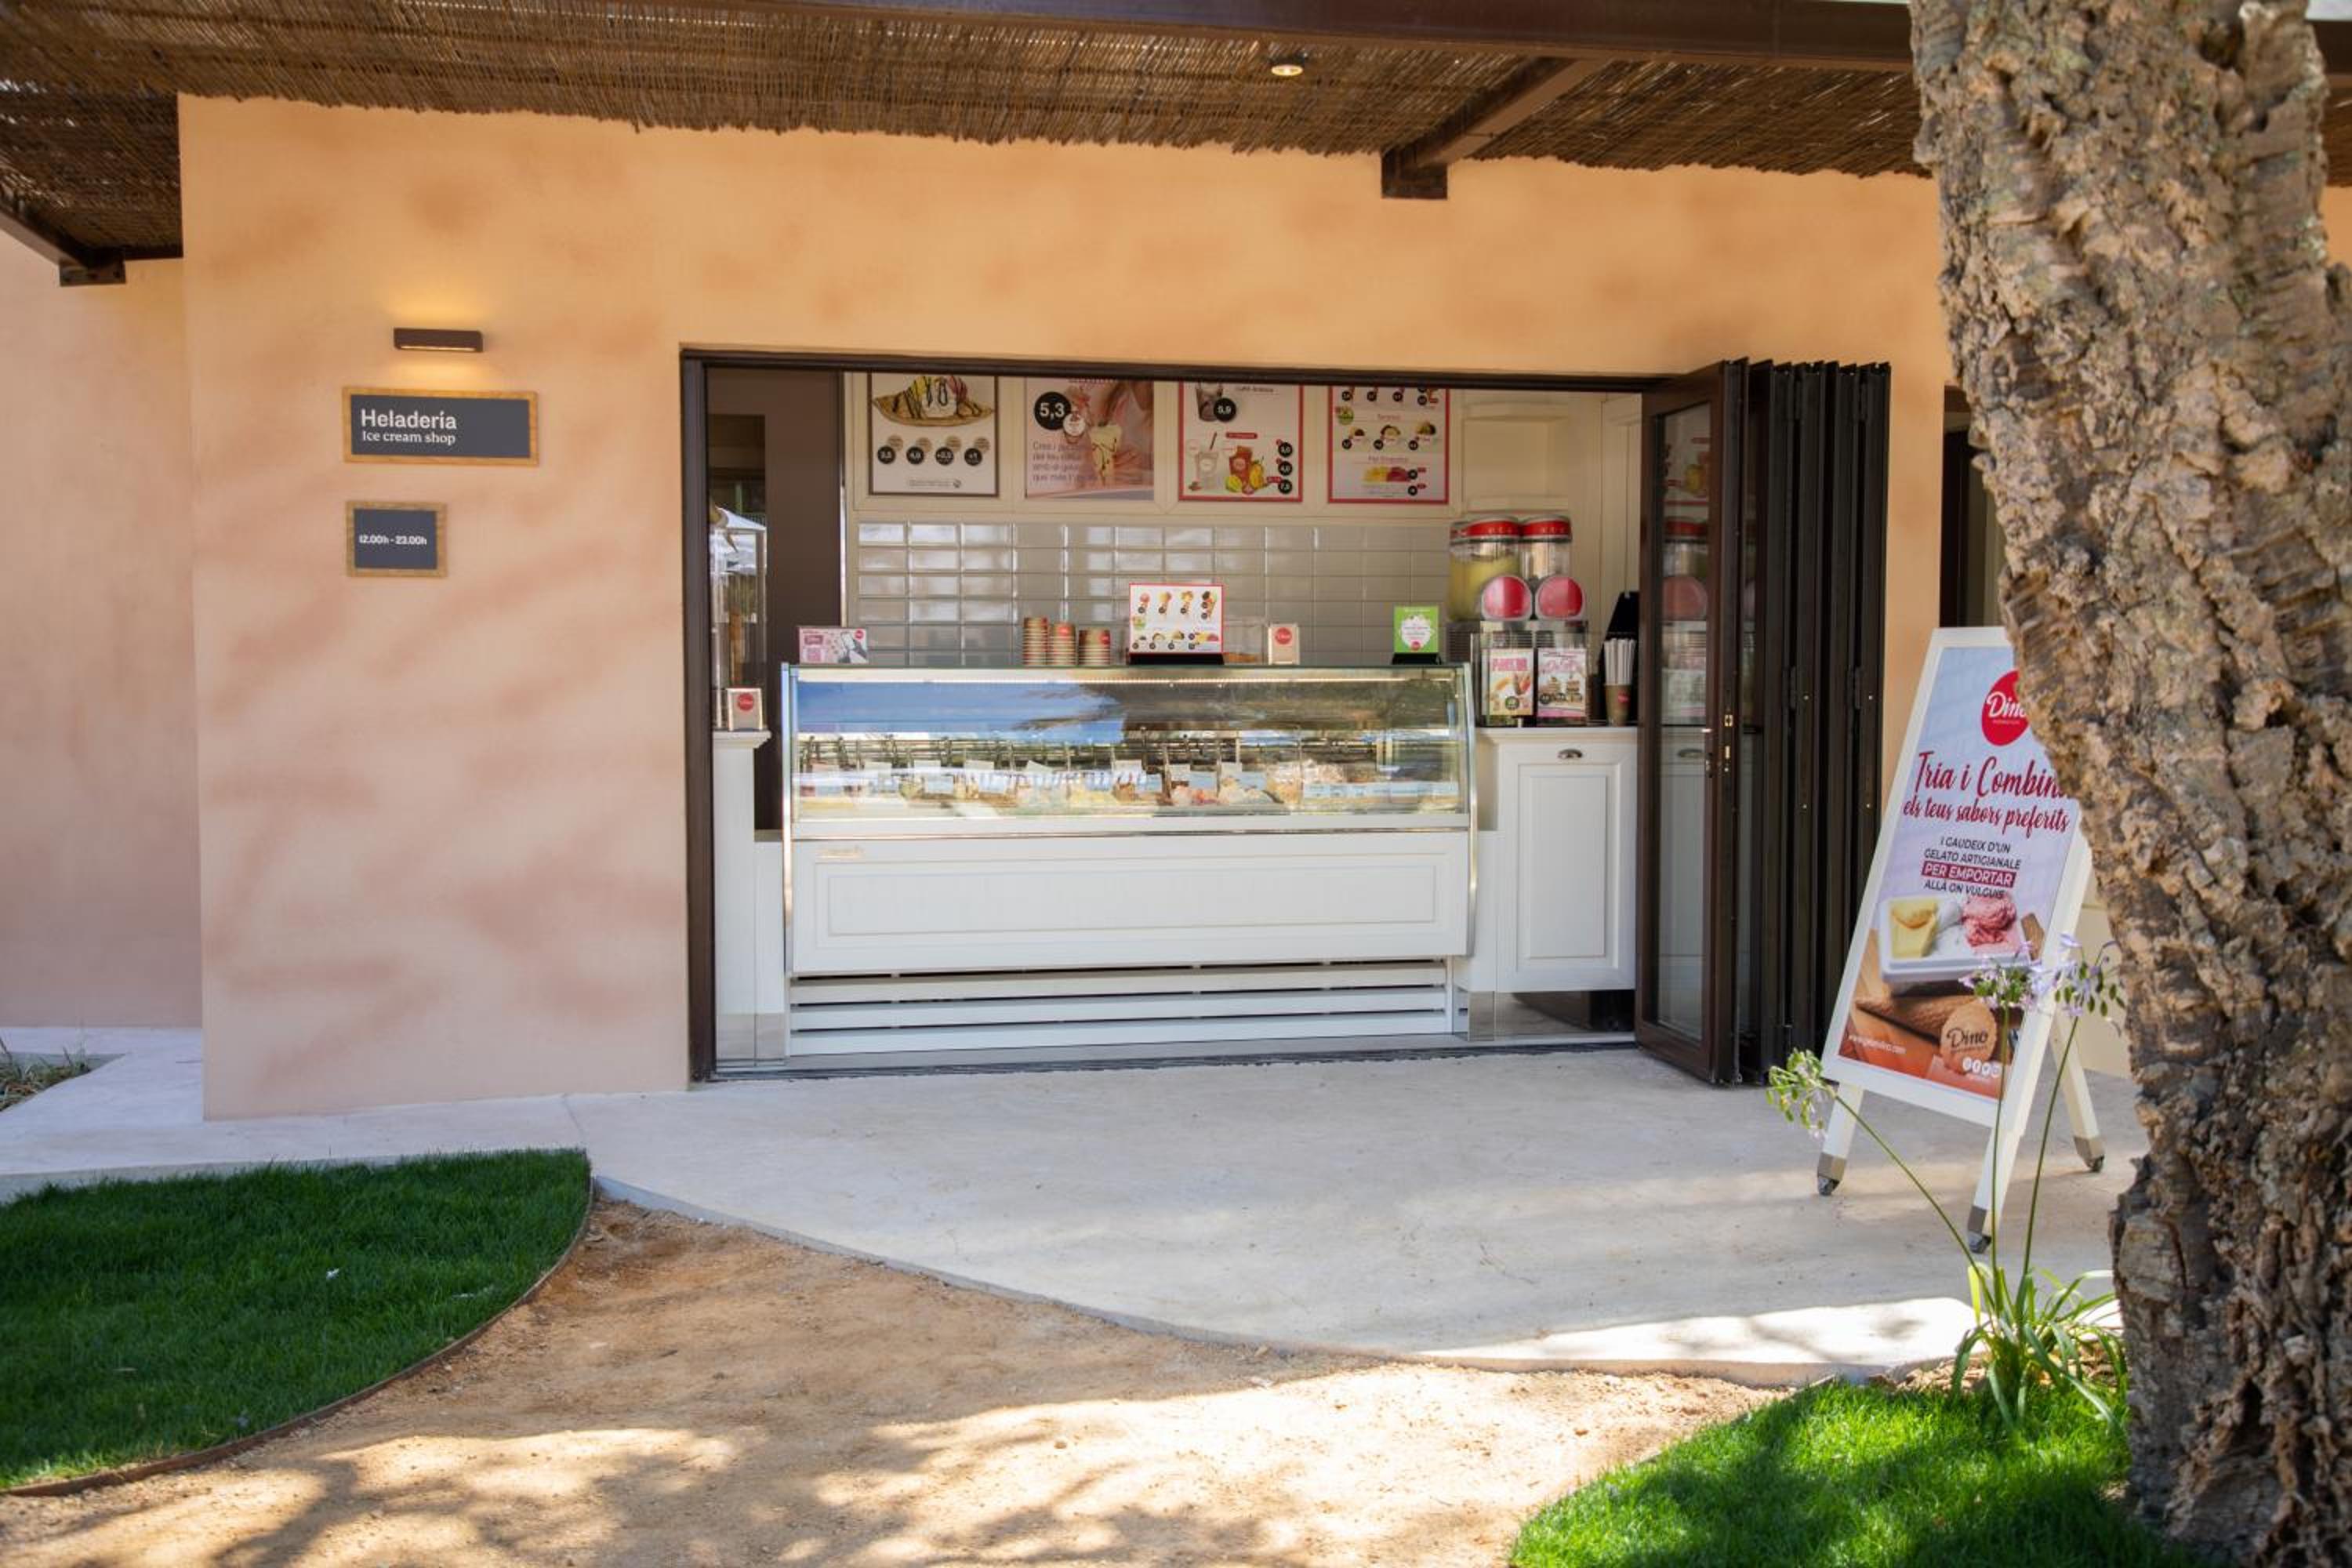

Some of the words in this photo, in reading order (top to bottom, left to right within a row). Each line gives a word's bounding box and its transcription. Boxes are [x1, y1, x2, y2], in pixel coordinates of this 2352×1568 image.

[361, 408, 457, 430] Heladería
[1040, 402, 1065, 420] 5,3
[362, 430, 381, 441] Ice
[383, 432, 423, 443] cream
[425, 432, 456, 446] shop
[358, 535, 390, 545] 12.00h
[1915, 750, 1957, 793] Tria
[1961, 764, 1971, 791] i
[1977, 756, 2068, 800] Combin
[1903, 795, 1922, 818] els
[1924, 797, 1953, 822] teus
[1955, 798, 2002, 826] sabors
[2002, 805, 2071, 839] preferits
[1945, 837, 1987, 851] GAUDEIX
[1987, 841, 2011, 854] D'UN
[1924, 848, 1959, 862] GELATO
[1959, 854, 2022, 869] ARTIGIANALE
[1924, 862, 1948, 877] PER
[1948, 866, 2013, 886] EMPORTAR
[1948, 883, 1963, 894] ON
[1947, 1027, 1988, 1048] Dino
